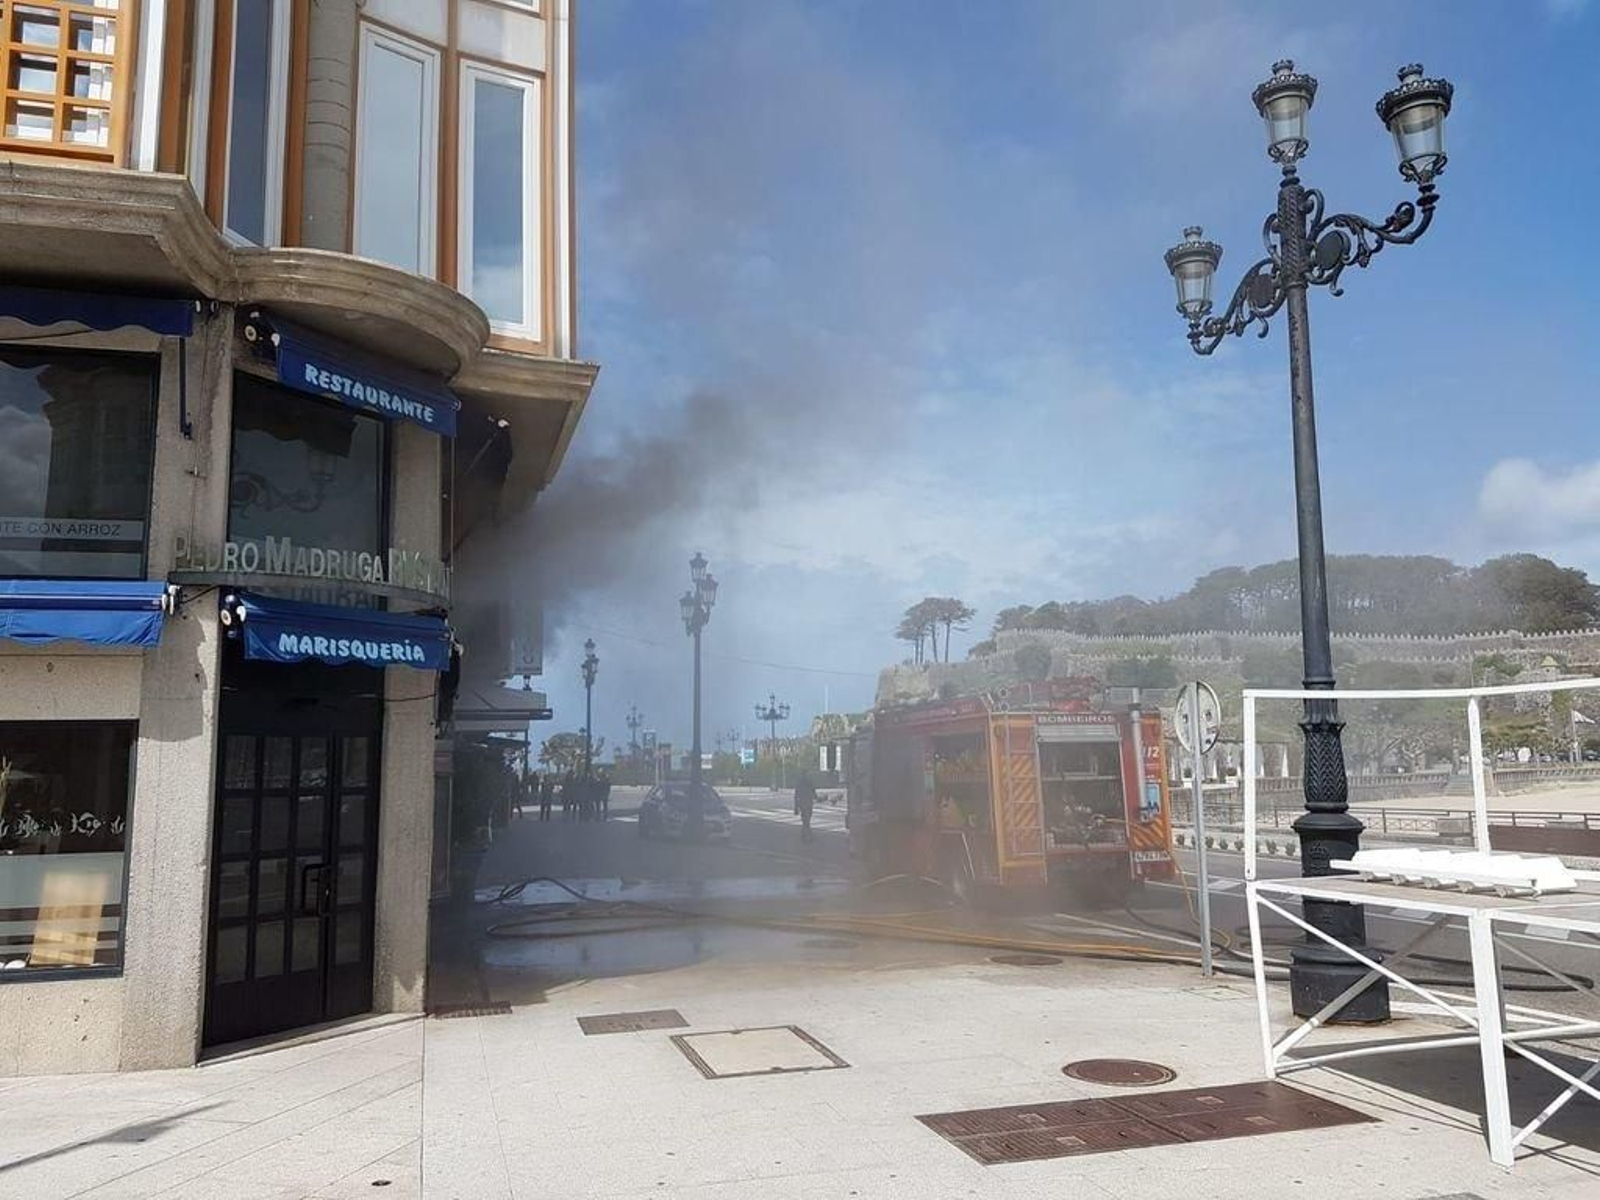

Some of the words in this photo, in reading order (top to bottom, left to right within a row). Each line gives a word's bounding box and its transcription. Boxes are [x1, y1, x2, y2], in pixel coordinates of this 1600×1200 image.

[304, 362, 435, 423] RESTAURANTE
[0, 521, 22, 533] TE
[26, 522, 62, 535] CON
[67, 523, 121, 537] ARROZ
[174, 536, 259, 572] PEDRO
[265, 535, 384, 584] MADRUGA
